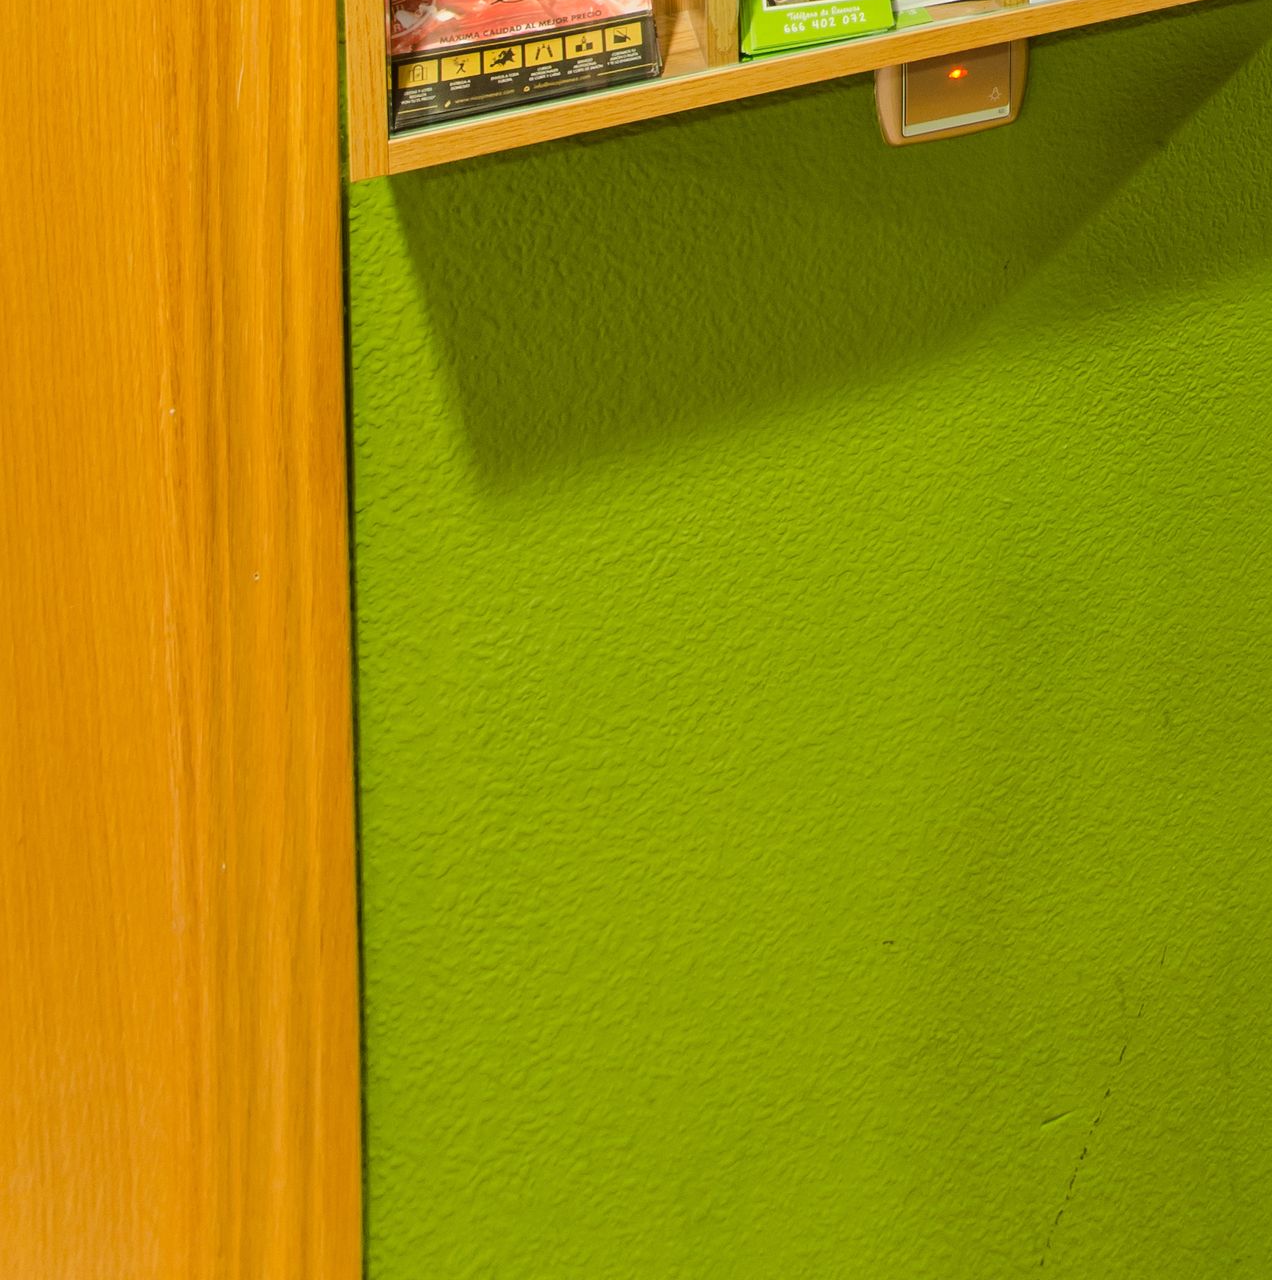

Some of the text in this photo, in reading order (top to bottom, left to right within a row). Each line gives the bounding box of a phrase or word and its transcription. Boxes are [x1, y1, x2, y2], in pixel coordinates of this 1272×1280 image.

[483, 10, 602, 37] CALIDAD AL MEJOR PRECIO
[784, 21, 806, 34] 666
[811, 16, 836, 30] 402
